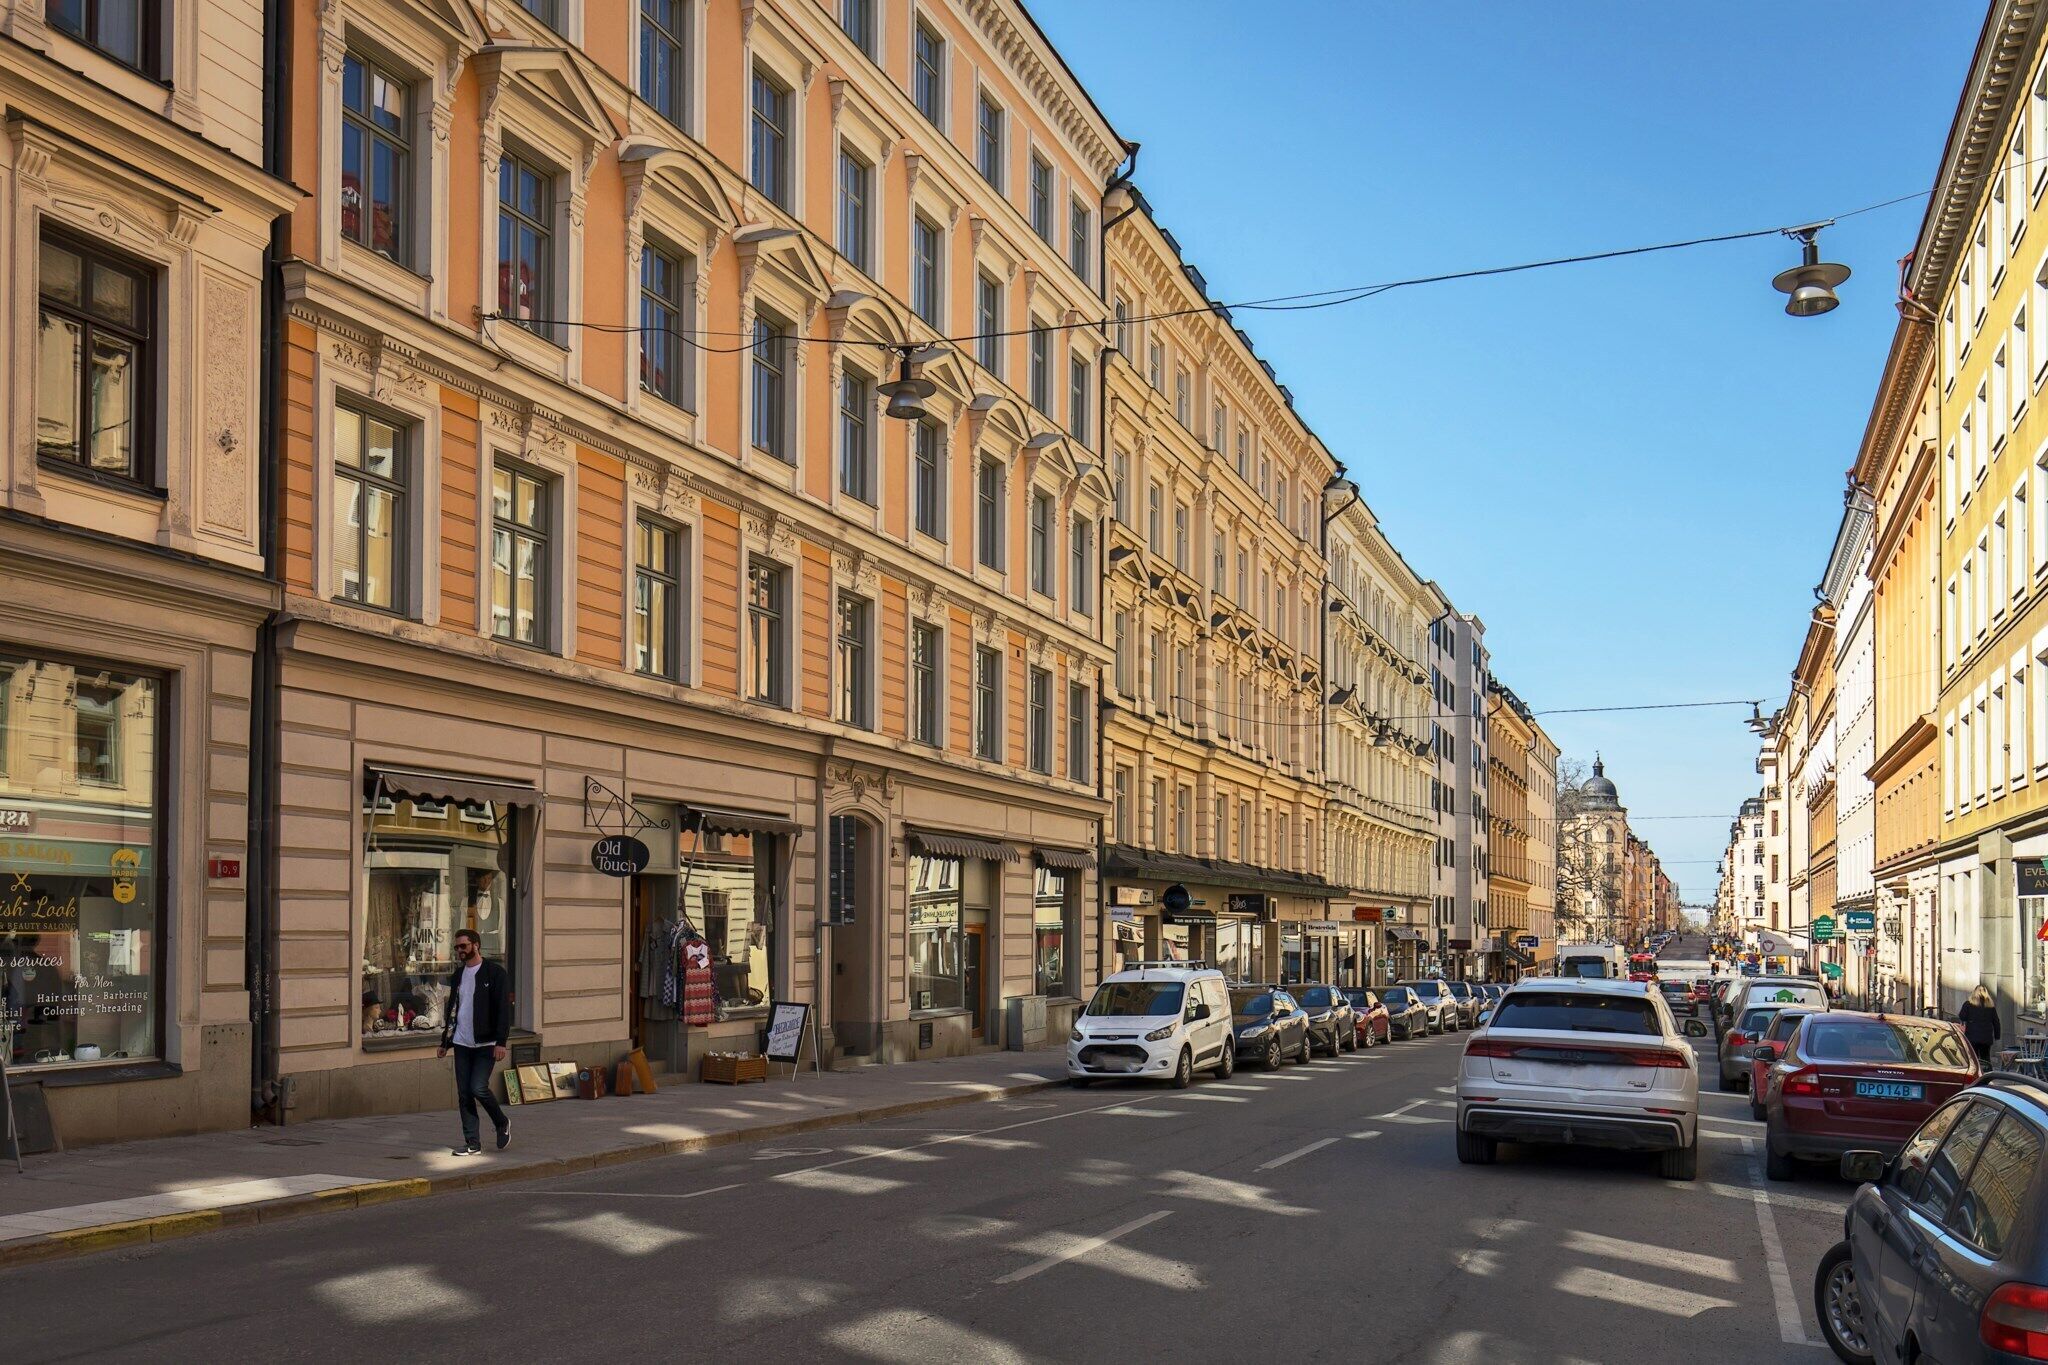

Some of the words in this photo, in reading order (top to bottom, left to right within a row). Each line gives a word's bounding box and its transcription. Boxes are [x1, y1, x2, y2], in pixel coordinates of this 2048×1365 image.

[597, 840, 621, 856] Old
[596, 855, 637, 873] Touch
[111, 870, 138, 878] BARBER
[31, 895, 78, 918] Look
[7, 922, 42, 930] BEAUTY
[43, 922, 77, 930] SALONG
[10, 953, 64, 967] services
[93, 974, 114, 989] Men
[37, 993, 59, 1003] Hair
[62, 992, 93, 1003] cuting
[103, 990, 148, 1001] Barbering
[43, 1006, 86, 1017] Coloring
[95, 1003, 142, 1014] Threading
